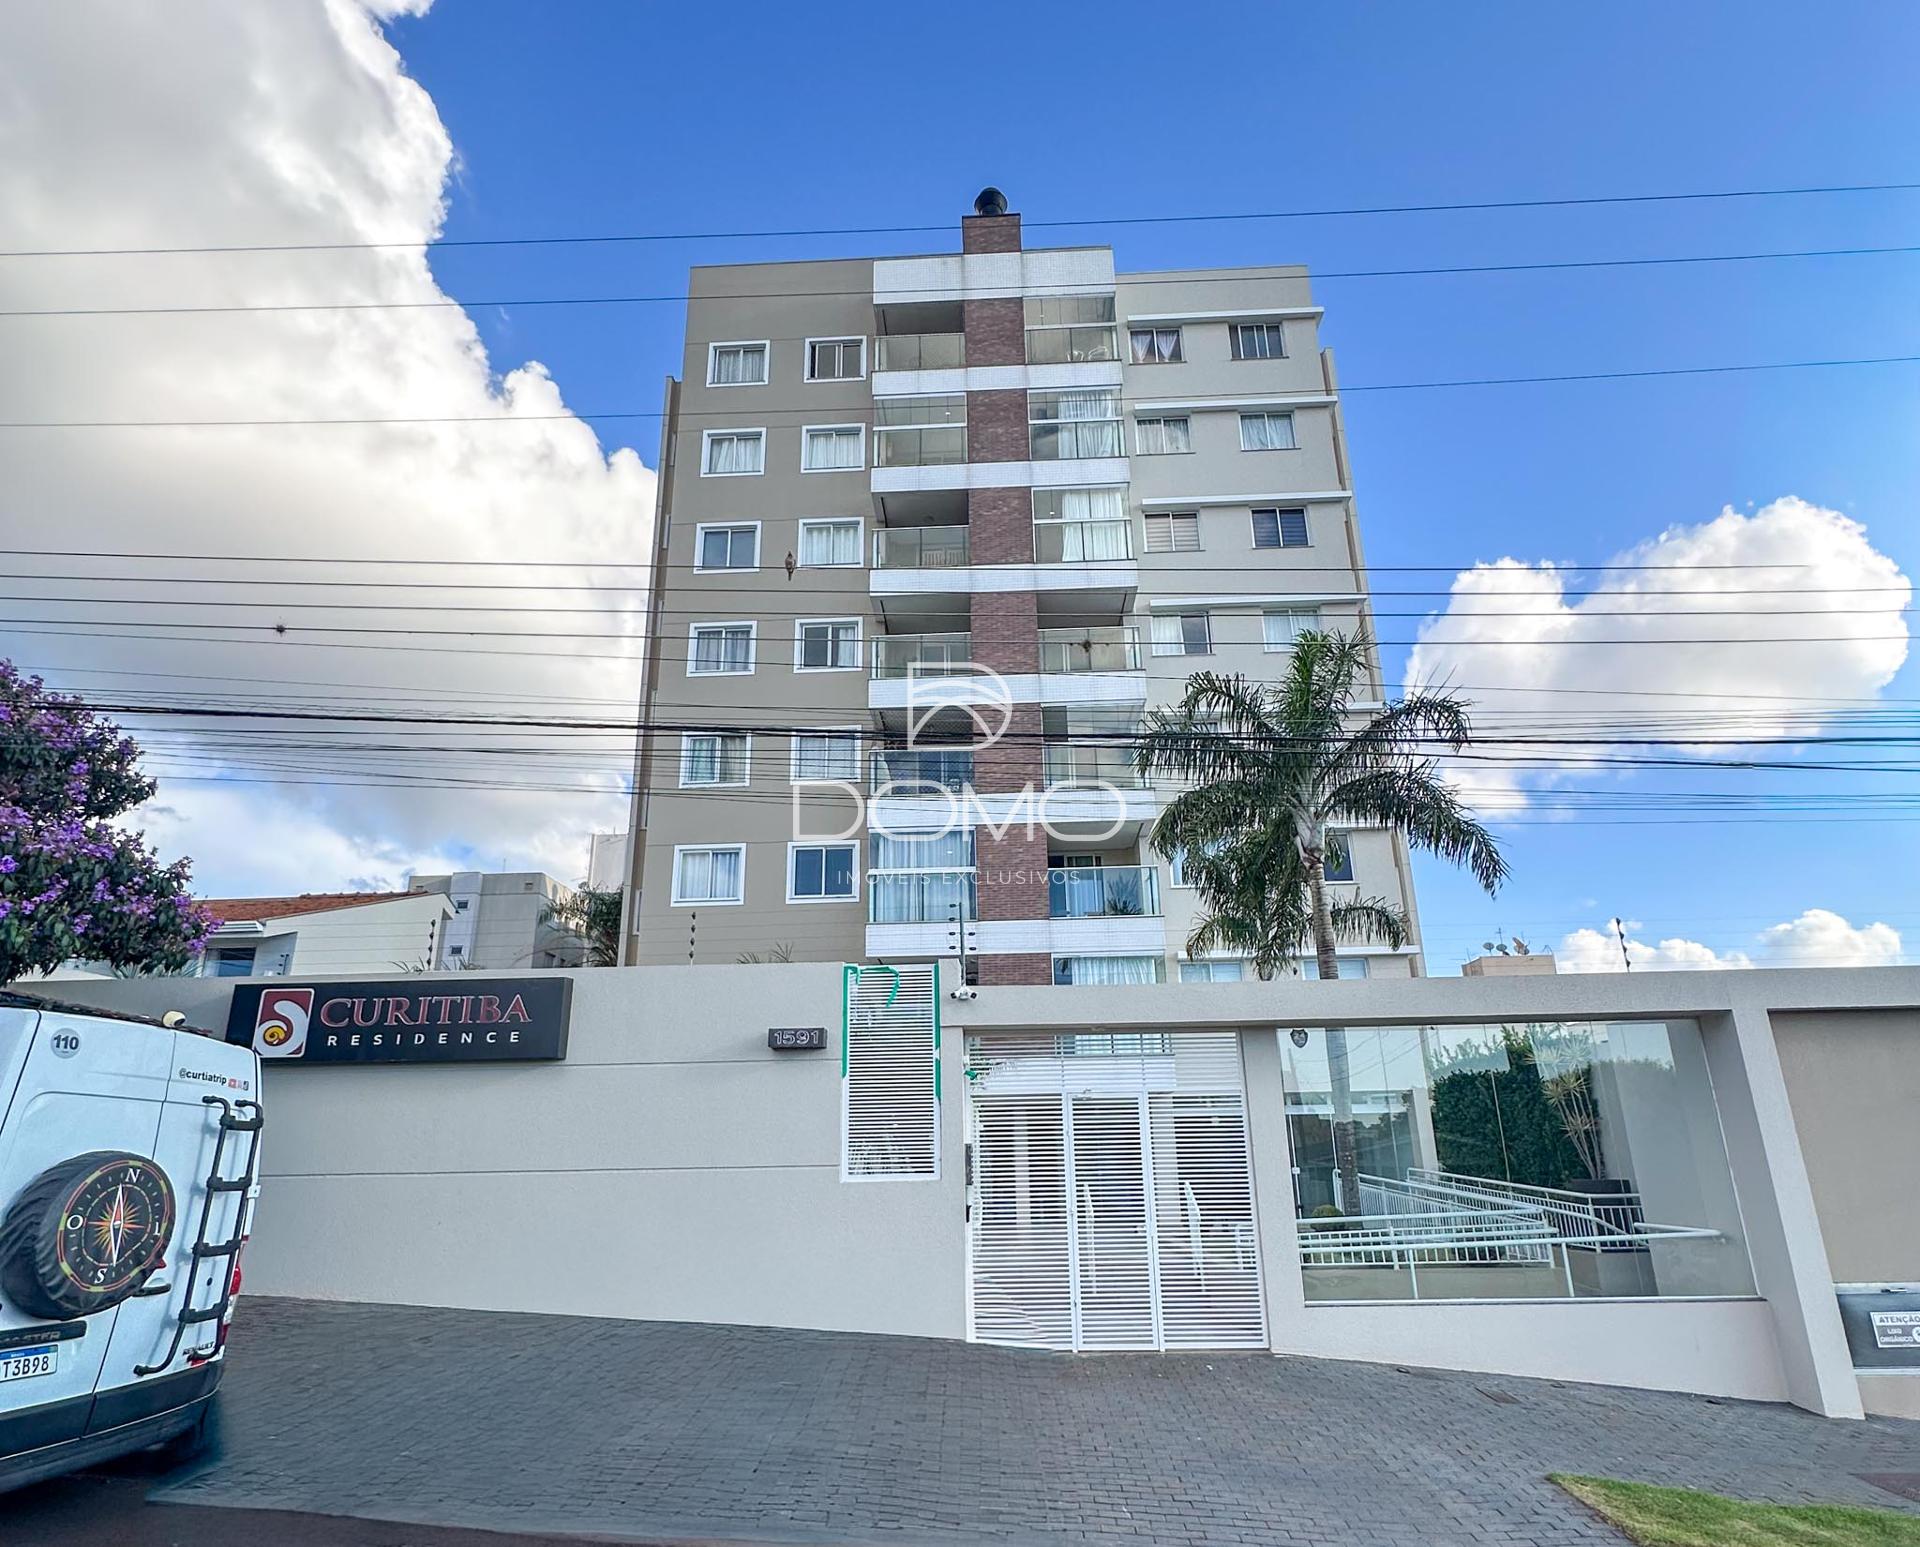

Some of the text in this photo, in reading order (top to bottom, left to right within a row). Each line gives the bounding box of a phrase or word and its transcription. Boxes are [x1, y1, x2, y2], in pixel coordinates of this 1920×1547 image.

[320, 993, 533, 1028] CURITIBA
[53, 1034, 80, 1050] 110
[326, 1031, 520, 1047] RESIDENCE
[773, 1030, 819, 1045] 1591
[179, 1067, 227, 1086] @curtiatrip
[125, 1168, 141, 1183] N
[66, 1214, 84, 1231] O
[94, 1268, 108, 1284] S
[3, 1356, 49, 1378] T3B98
